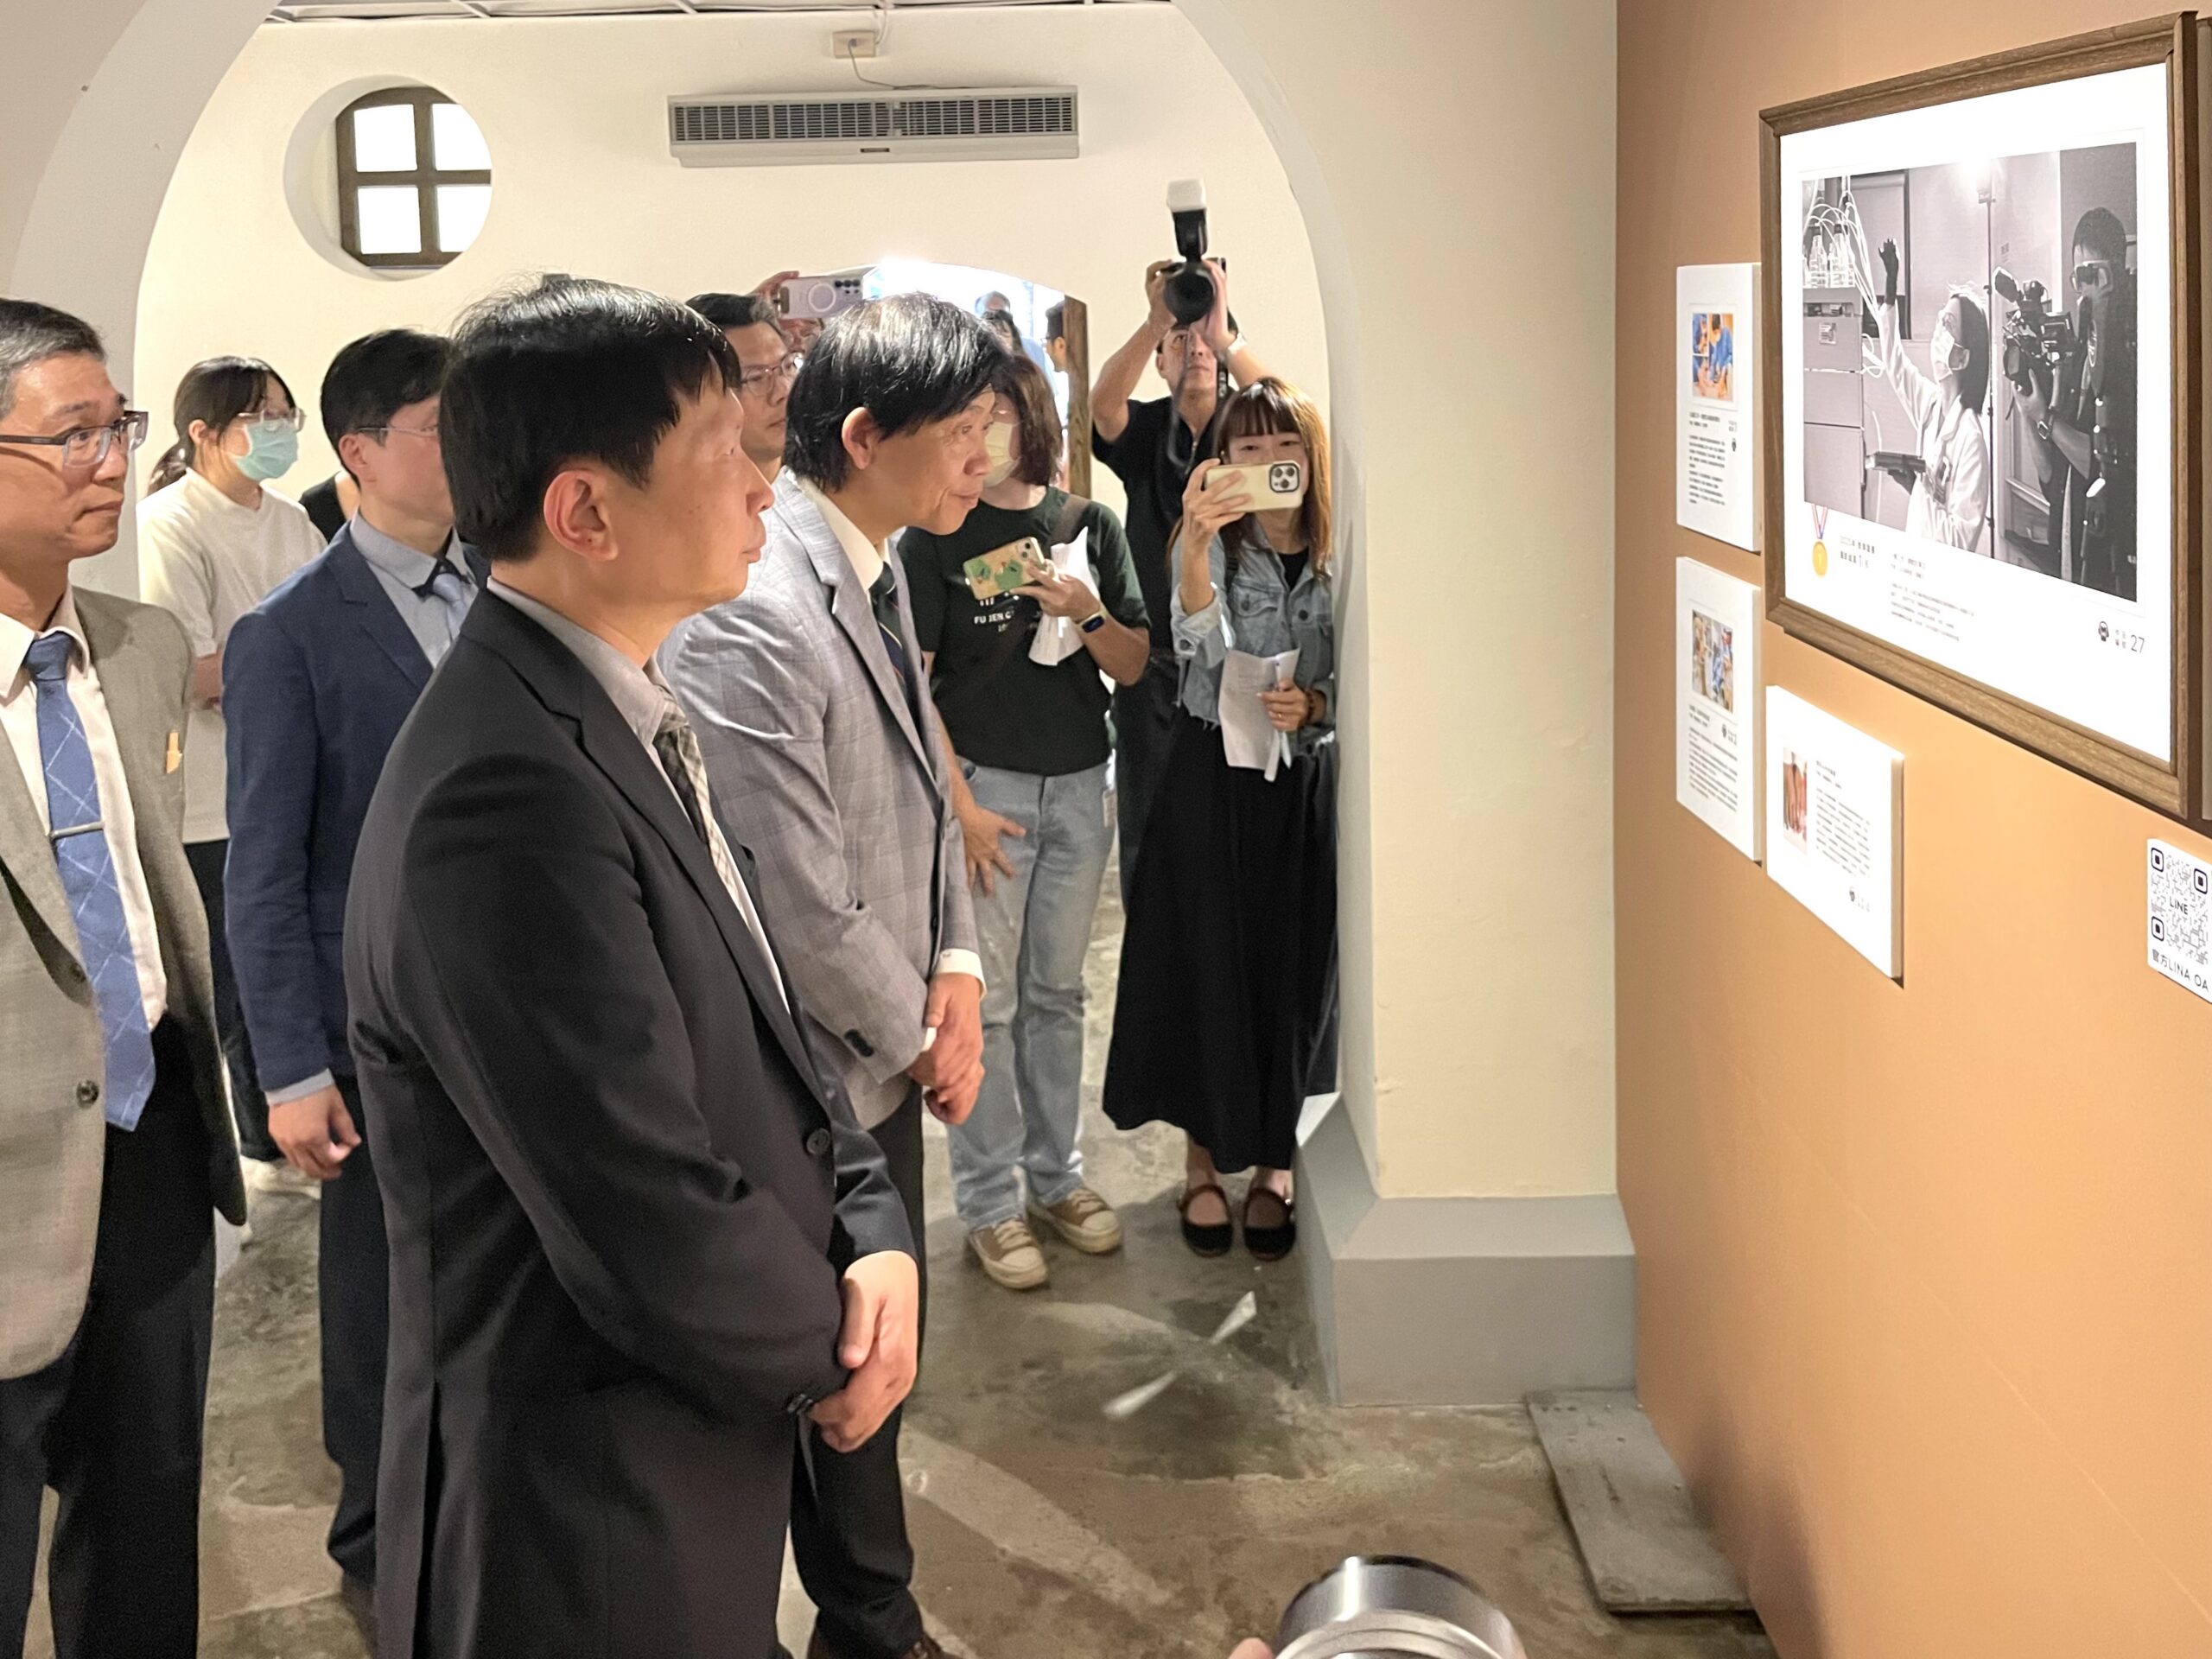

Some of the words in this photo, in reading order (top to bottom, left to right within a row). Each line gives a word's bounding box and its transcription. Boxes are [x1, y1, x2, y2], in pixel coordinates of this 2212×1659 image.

[988, 613, 1004, 622] JEN
[2131, 634, 2145, 653] 27
[2169, 896, 2189, 915] LINE
[2194, 973, 2209, 993] OA
